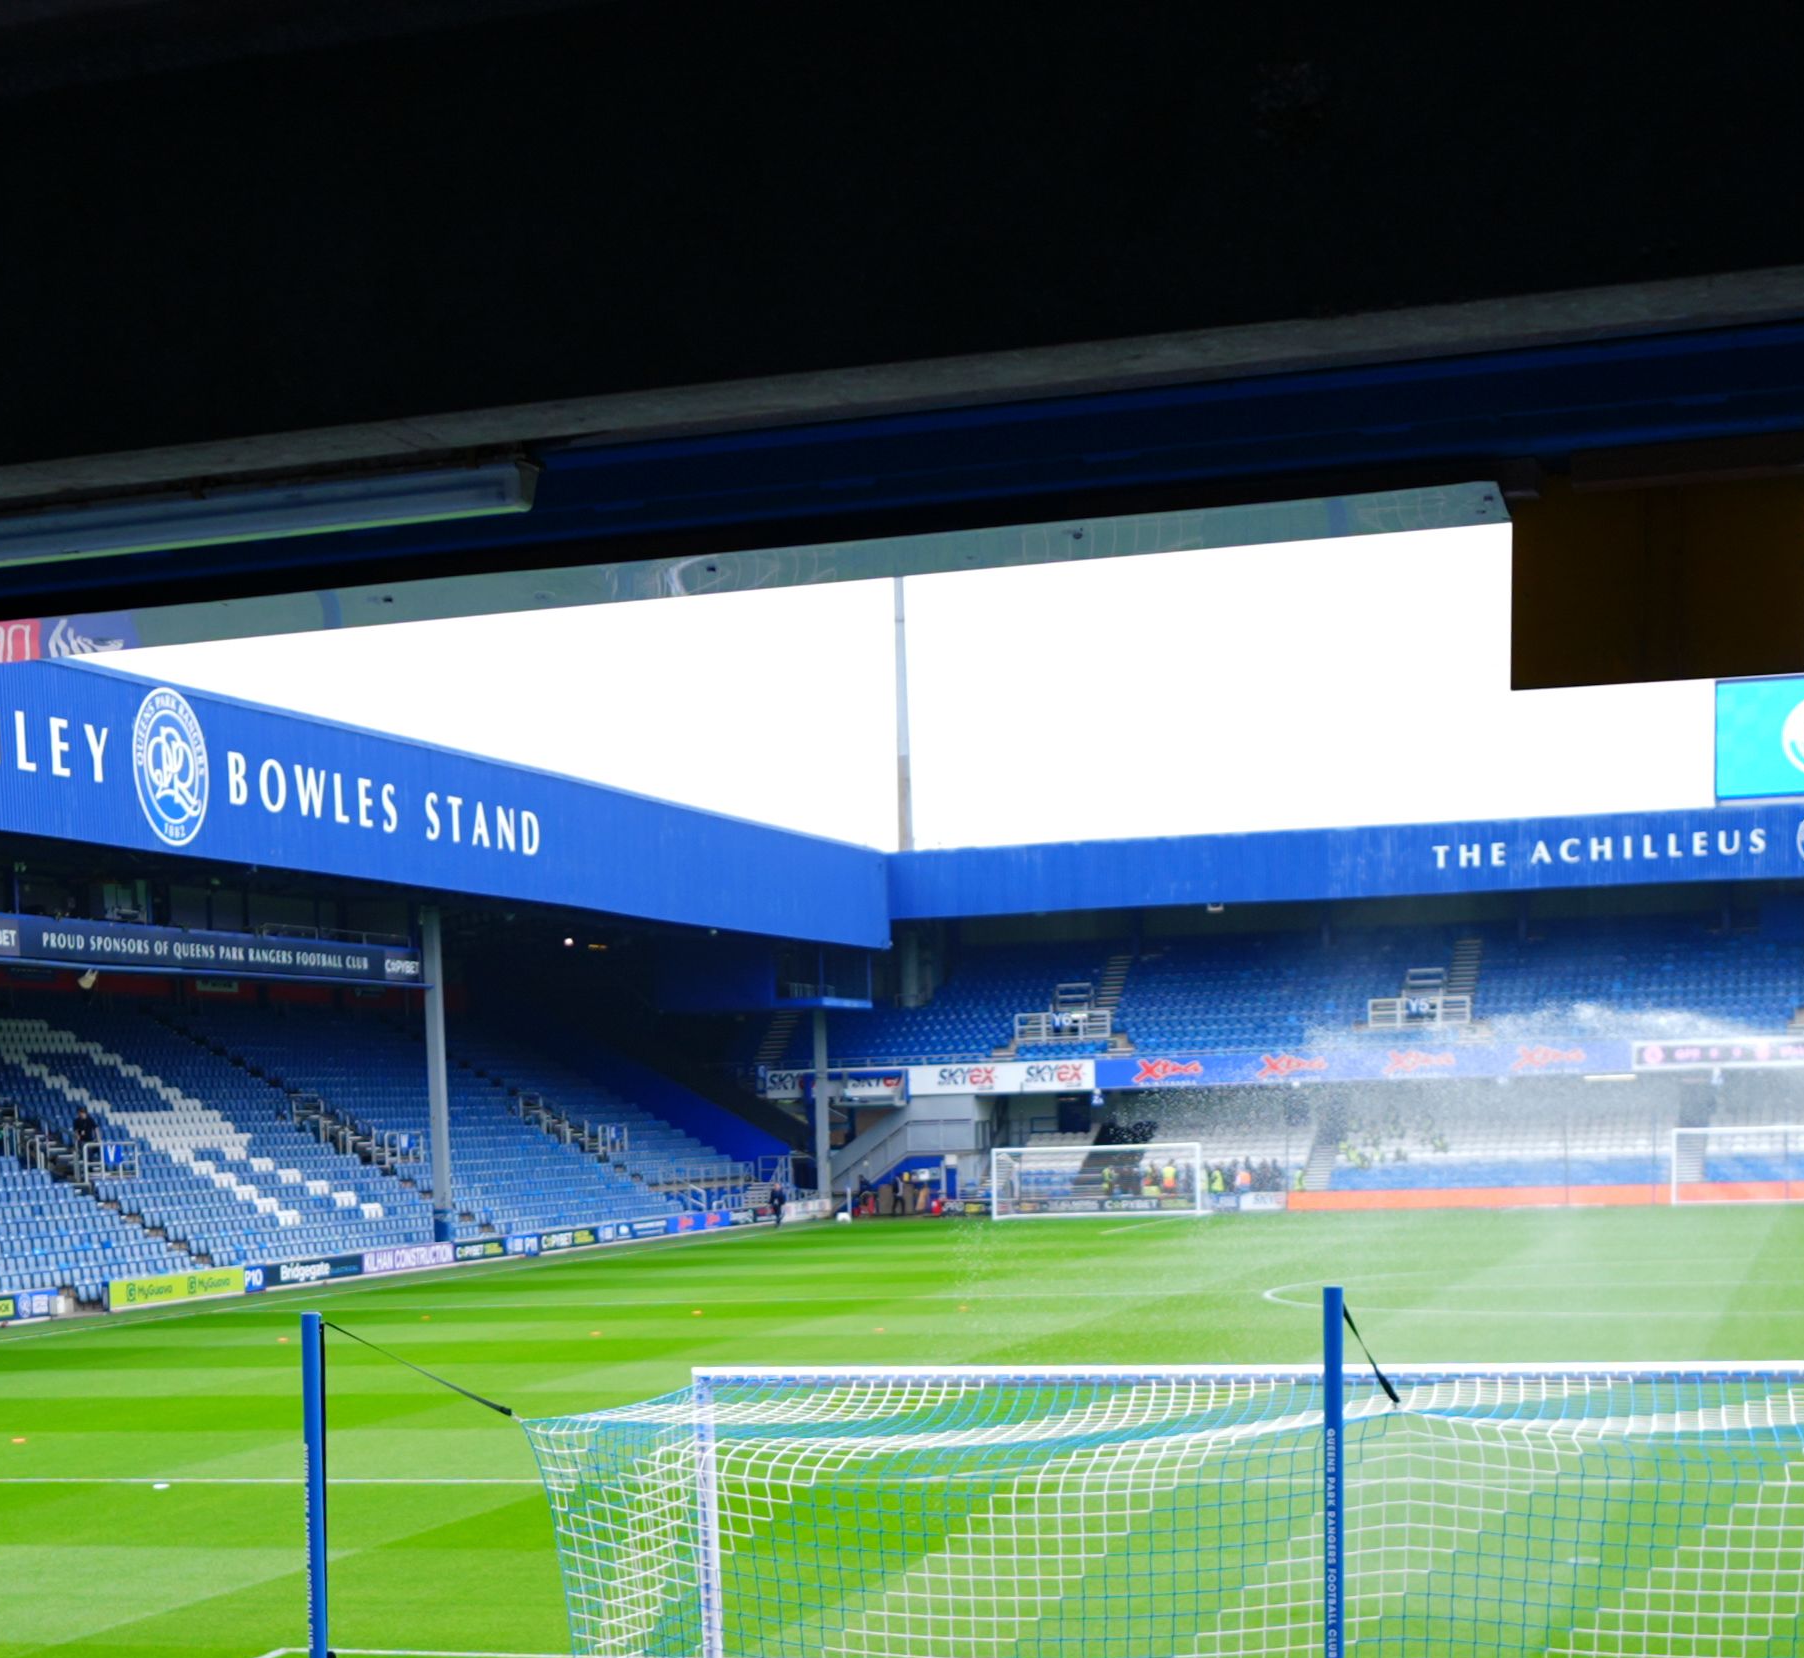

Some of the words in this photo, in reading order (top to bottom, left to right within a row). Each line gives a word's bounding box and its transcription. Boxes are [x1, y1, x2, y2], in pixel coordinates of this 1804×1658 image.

[226, 750, 399, 835] BOWLES
[424, 791, 541, 857] STAND
[1432, 842, 1506, 869] THE
[1531, 828, 1767, 865] ACHILLEUS
[42, 931, 86, 950] PROUD
[89, 936, 150, 955] SPONSORS
[154, 940, 169, 956] OF
[173, 941, 216, 961] QUEENS
[219, 945, 245, 962] PARK
[248, 948, 294, 965] RANGERS
[296, 951, 344, 969] FOOTBALL
[346, 955, 370, 970] CLUB
[1052, 1012, 1073, 1027] Y6
[279, 1261, 332, 1283] Bridgegate
[363, 1250, 395, 1273] KILHAN
[395, 1243, 454, 1268] CONSTRUCTION
[244, 1269, 264, 1287] P10
